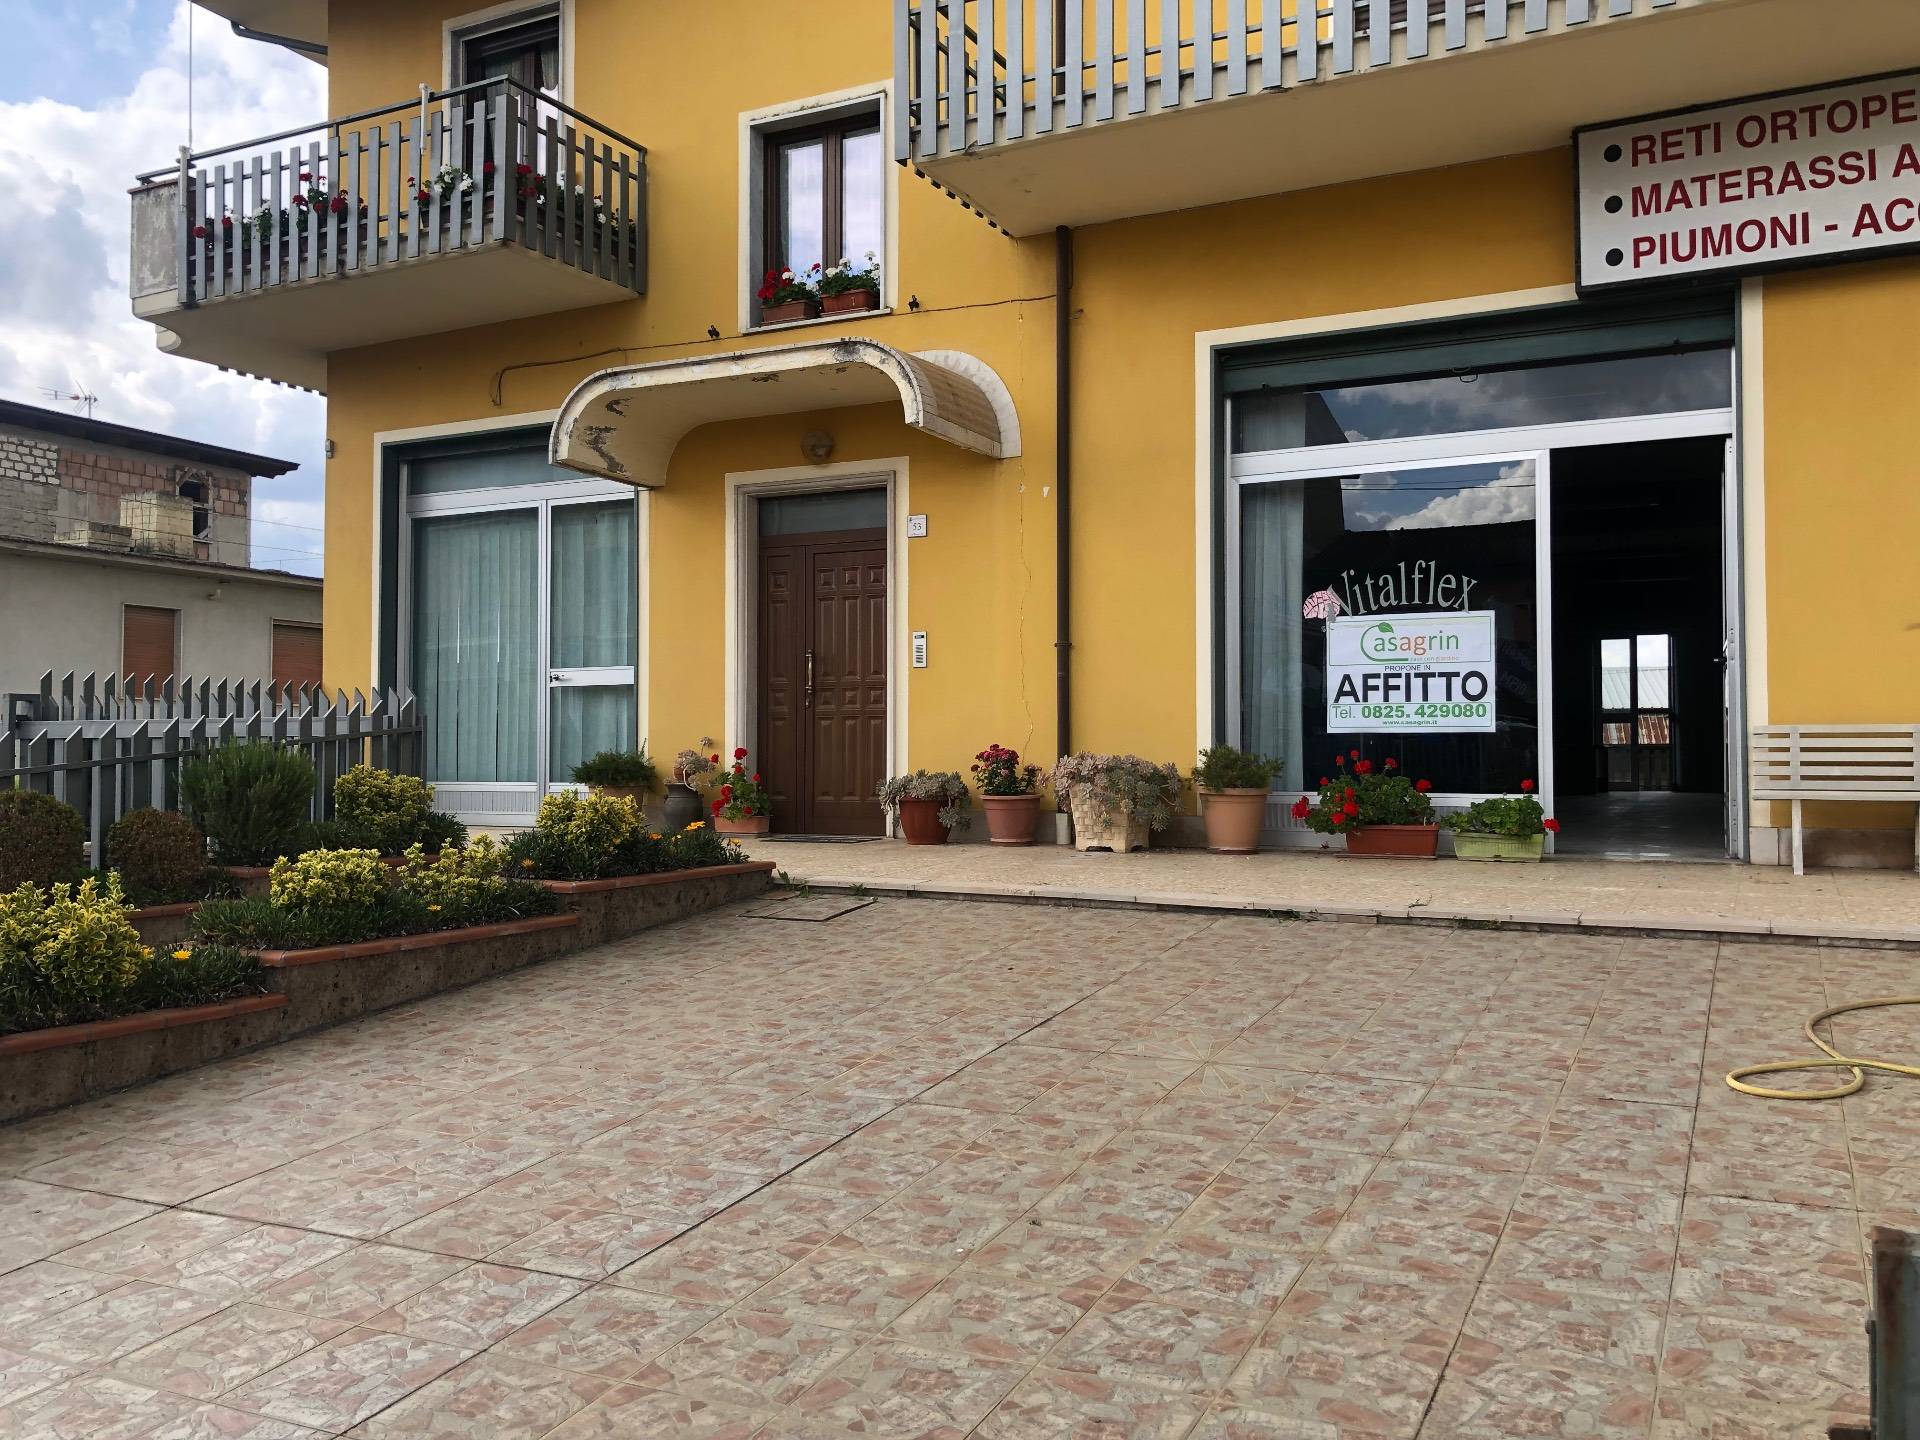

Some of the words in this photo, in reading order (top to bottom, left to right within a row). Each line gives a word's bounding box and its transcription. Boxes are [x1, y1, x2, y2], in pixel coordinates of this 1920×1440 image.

[1631, 122, 1721, 167] RETI
[1736, 89, 1918, 148] ORTOPE
[1631, 149, 1877, 217] MATERASSI
[1892, 143, 1920, 178] A
[1632, 212, 1810, 268] PIUMONI
[1852, 198, 1920, 238] AC
[912, 522, 921, 531] 53
[1327, 560, 1480, 618] Vitalflex
[1360, 622, 1459, 662] Casagrin
[1333, 670, 1488, 704] AFFITTO
[1332, 706, 1356, 719] Tel.
